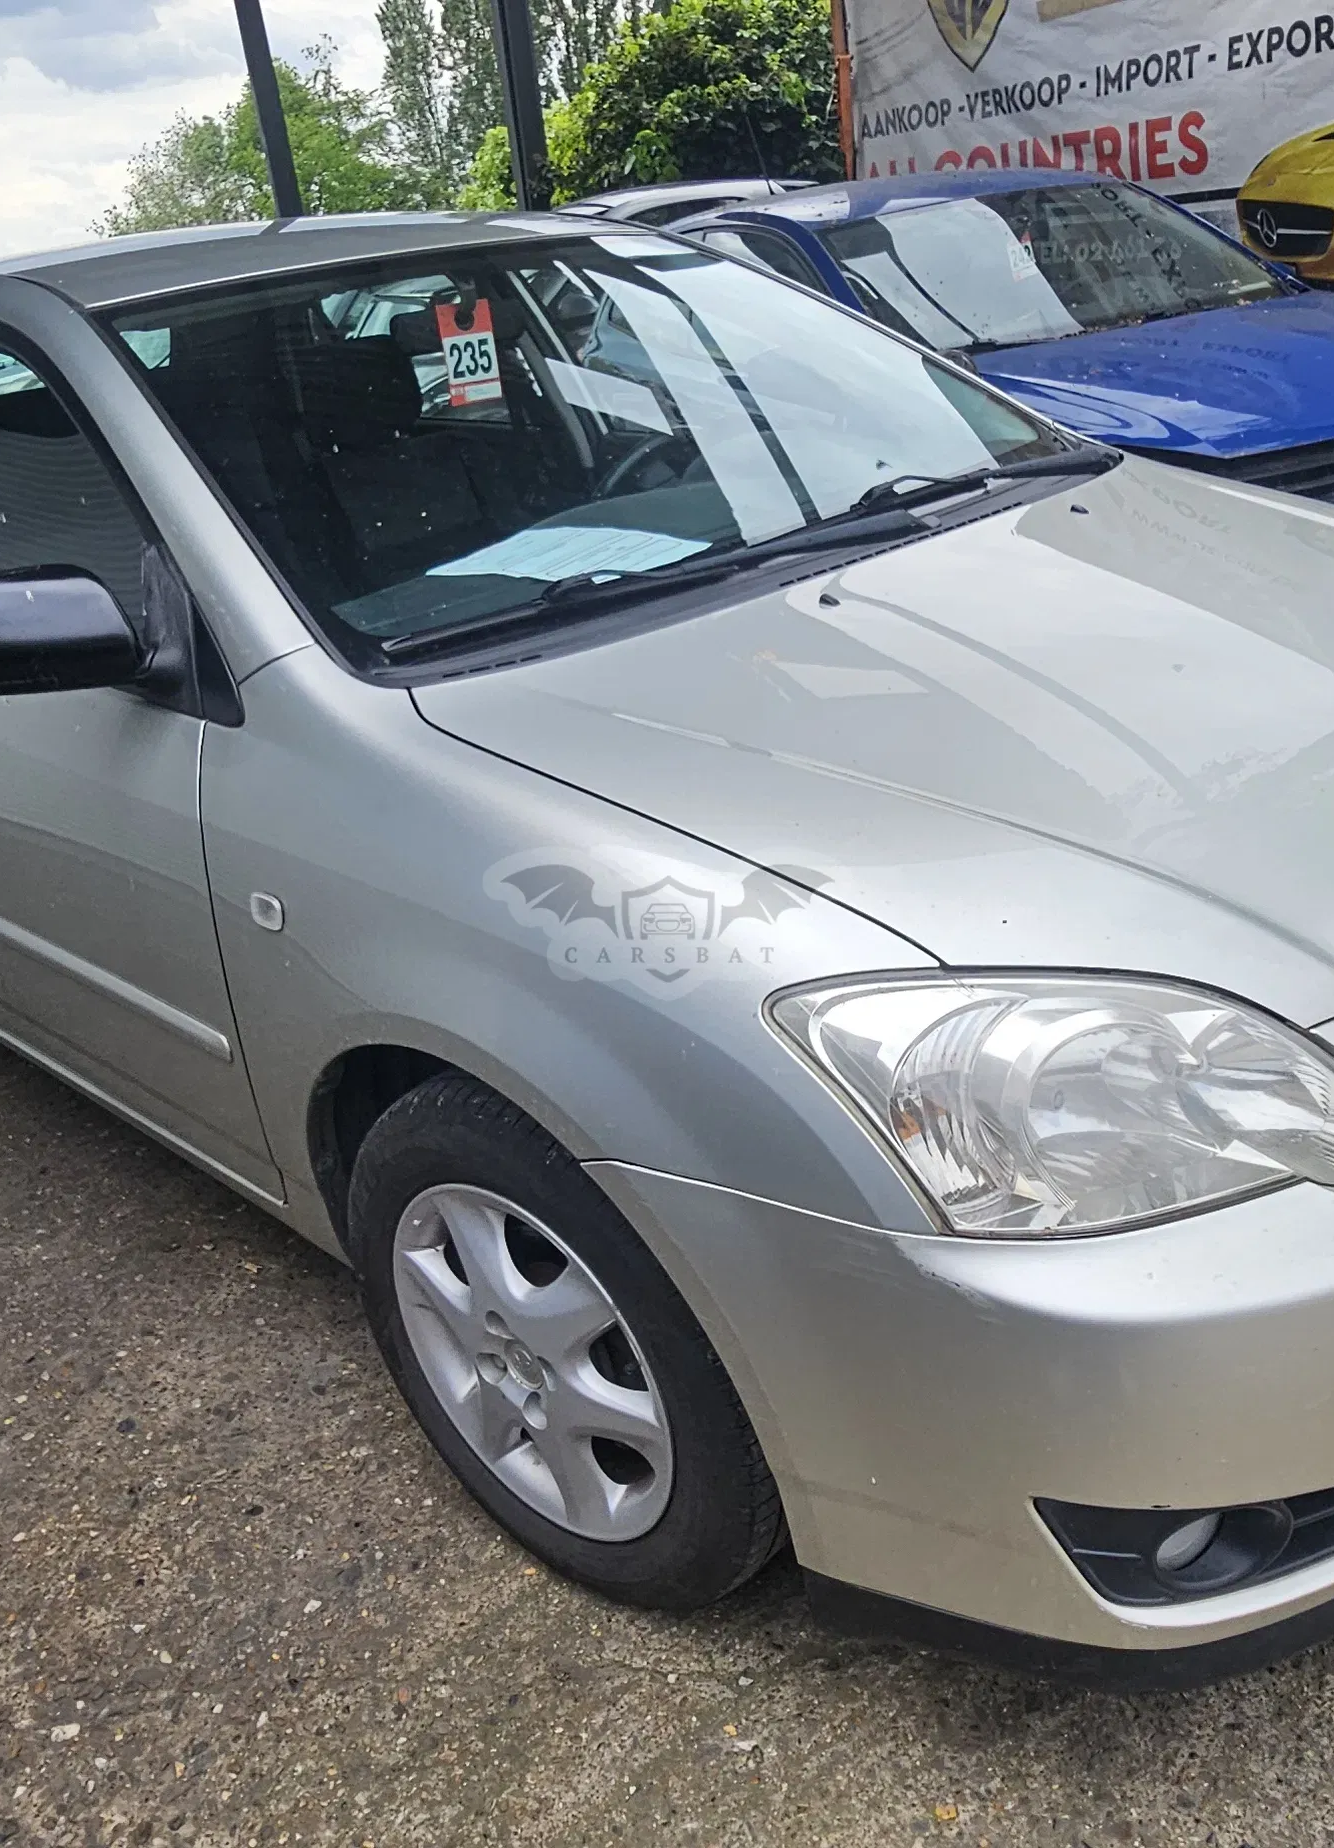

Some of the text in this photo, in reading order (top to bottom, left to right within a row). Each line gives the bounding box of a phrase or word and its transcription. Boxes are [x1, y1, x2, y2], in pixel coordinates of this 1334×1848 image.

[861, 98, 952, 140] AANKOOP
[1095, 43, 1202, 97] IMPORT
[449, 338, 492, 380] 235
